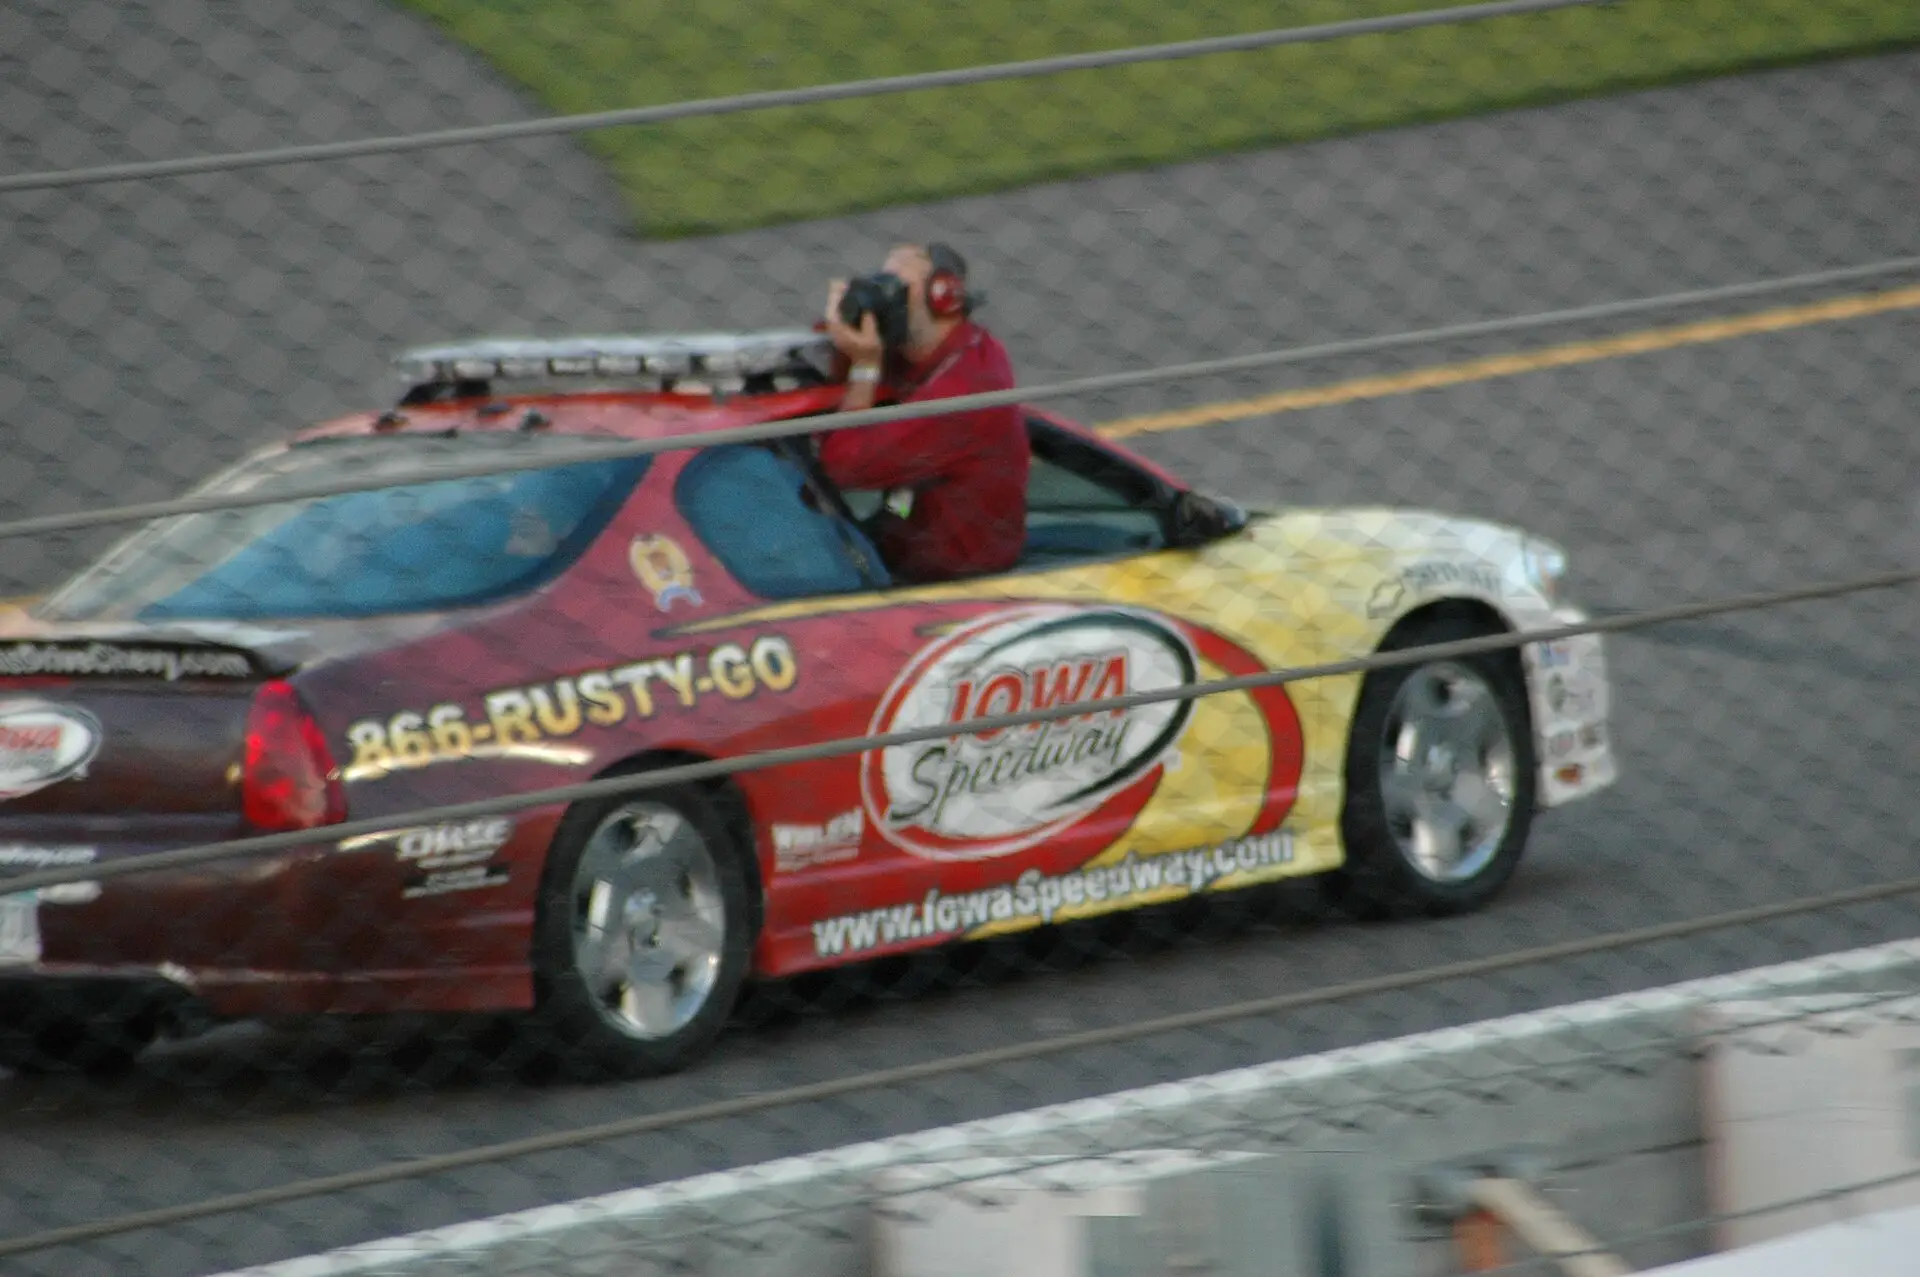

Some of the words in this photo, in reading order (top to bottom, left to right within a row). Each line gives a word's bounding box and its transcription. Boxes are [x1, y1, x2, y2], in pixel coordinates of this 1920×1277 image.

[347, 635, 797, 779] 866-RUSTY-GO
[948, 655, 1127, 744] IOWA
[888, 720, 1132, 825] Speedway
